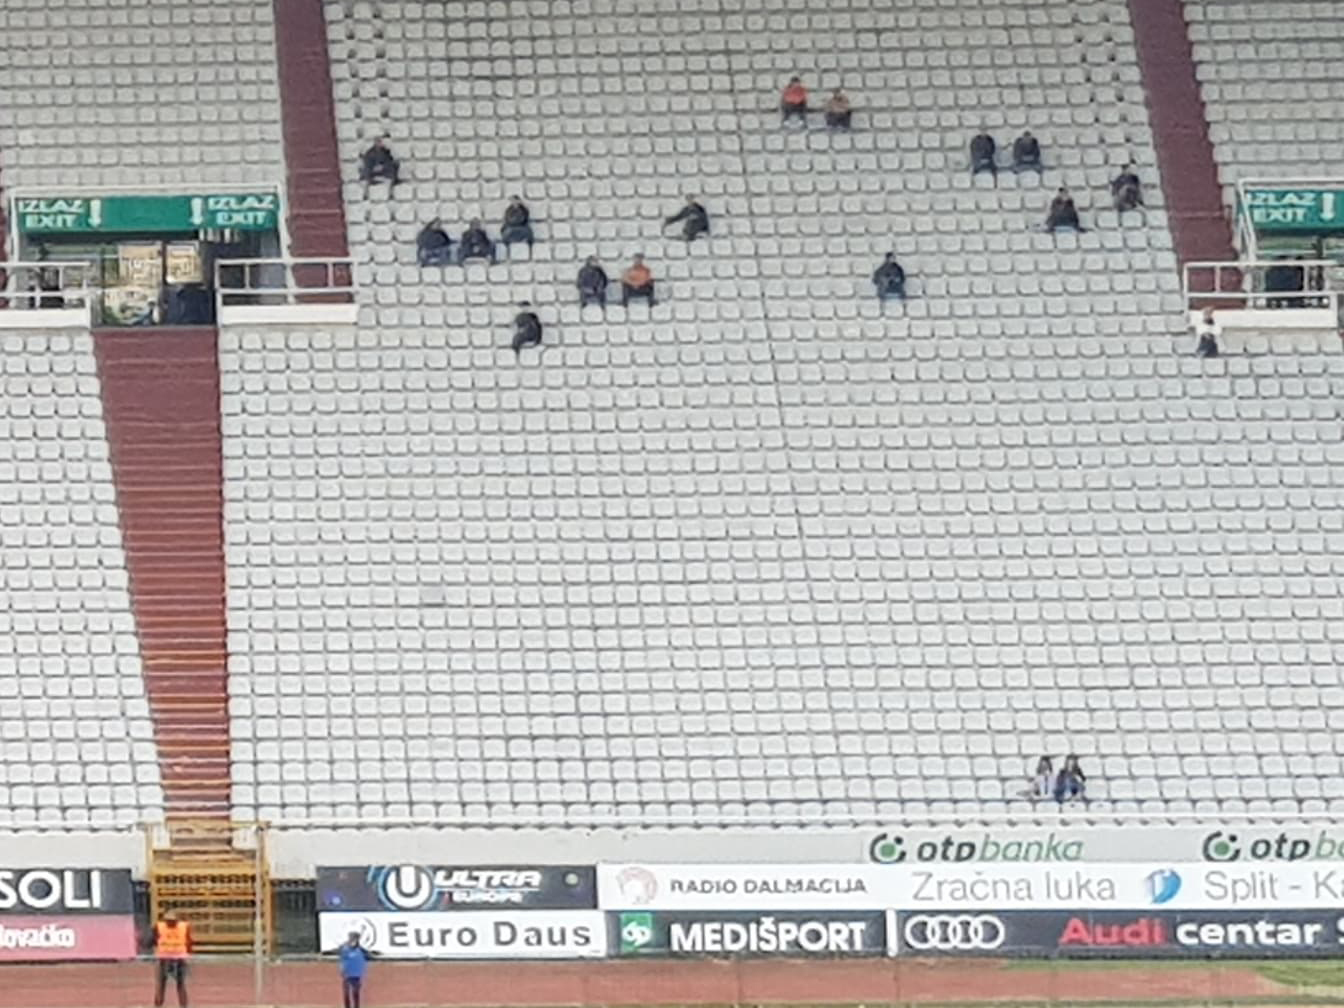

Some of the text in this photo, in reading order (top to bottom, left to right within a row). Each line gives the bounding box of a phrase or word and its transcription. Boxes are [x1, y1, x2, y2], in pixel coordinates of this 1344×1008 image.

[19, 200, 84, 213] IZLAZ
[208, 196, 274, 210] IZLAZ
[1247, 192, 1316, 206] IZLAZ
[25, 214, 77, 228] EXIT
[216, 212, 267, 225] EXIT
[1253, 208, 1307, 222] EXIT
[433, 869, 542, 888] ULTRA
[670, 878, 868, 894] RADIO DALMACIJA
[912, 870, 1117, 902] Zračna luka
[1203, 869, 1280, 905] Split
[387, 920, 592, 947] Euro Daus
[670, 916, 866, 952] MEDIŠPORT
[1058, 916, 1163, 945] Audi
[1175, 920, 1324, 945] centar
